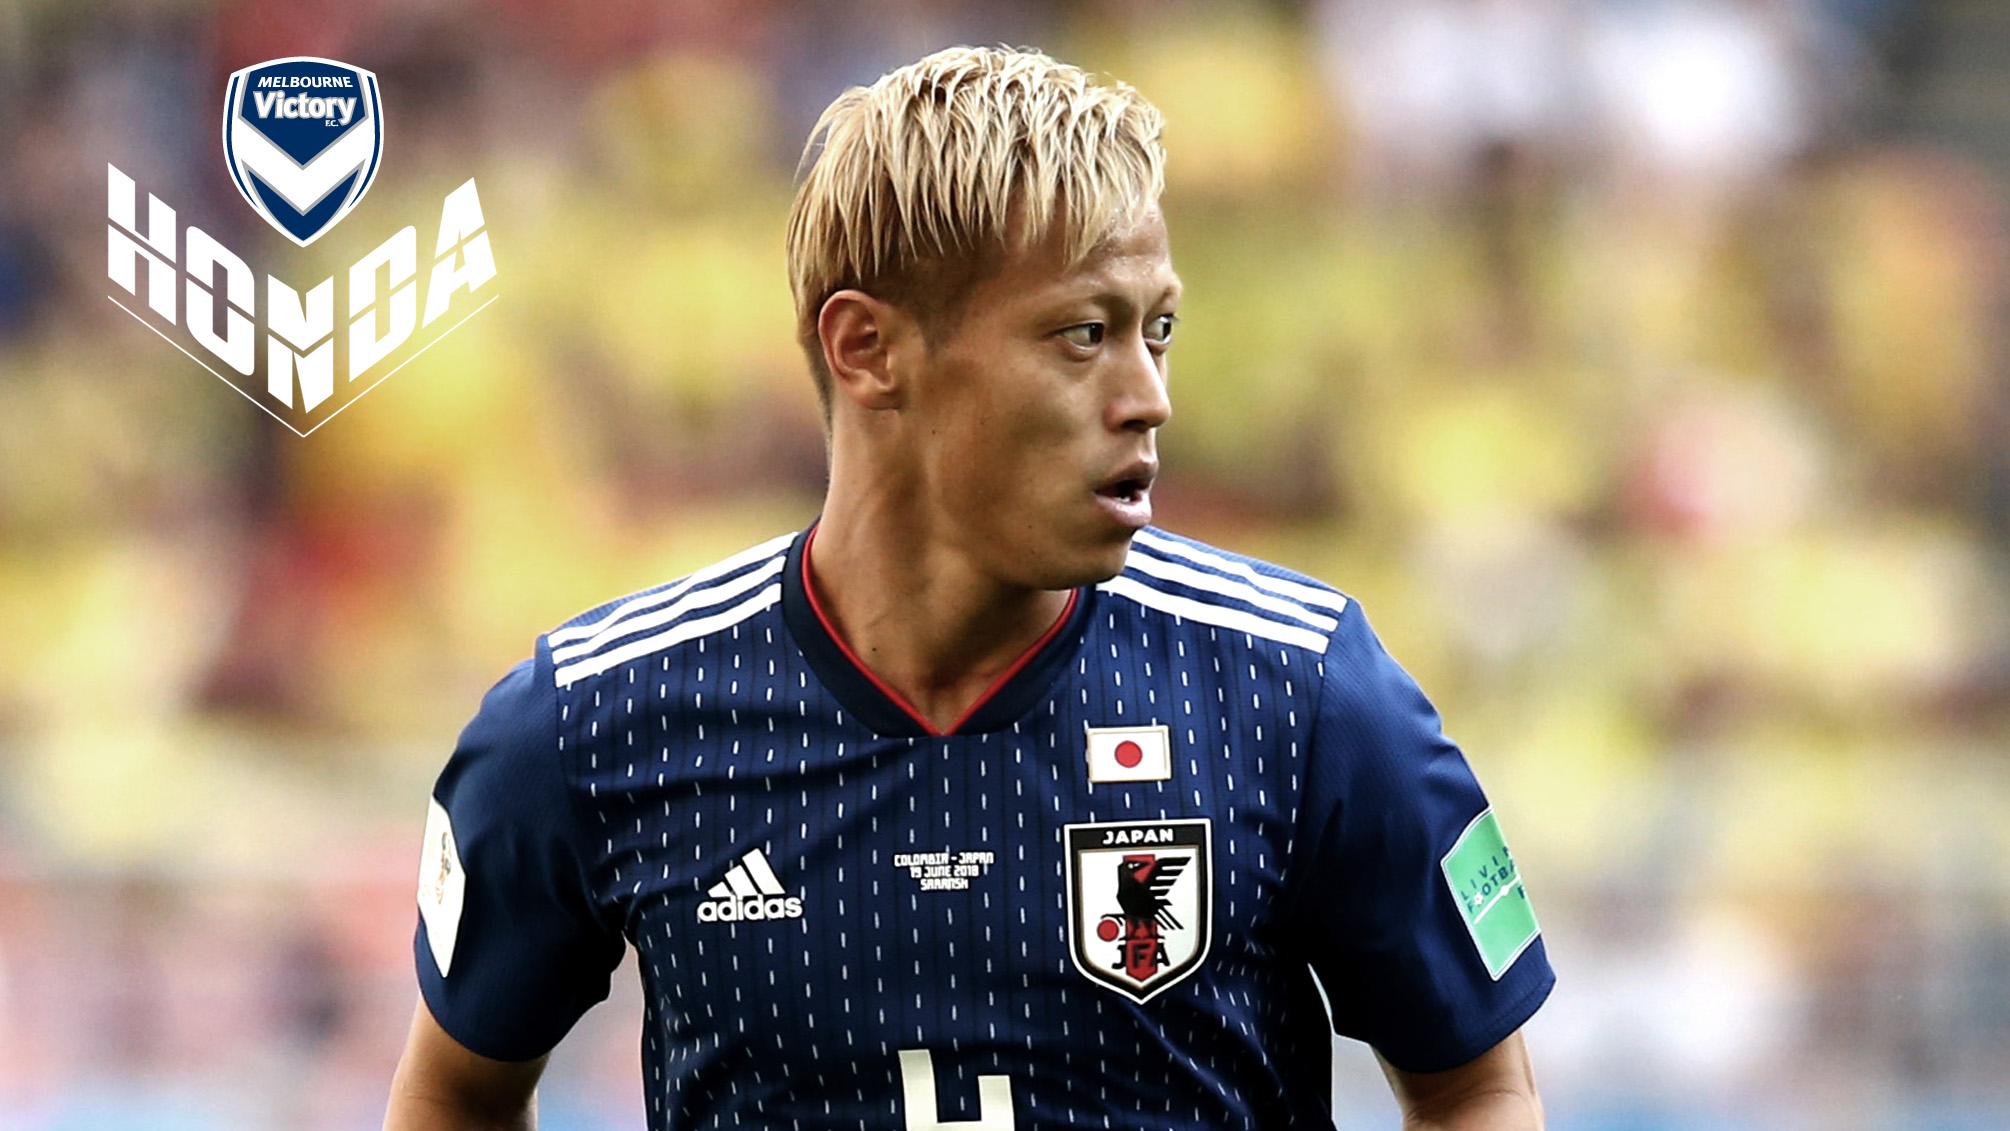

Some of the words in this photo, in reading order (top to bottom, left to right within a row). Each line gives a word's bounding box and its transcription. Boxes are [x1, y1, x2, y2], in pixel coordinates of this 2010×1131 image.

[1102, 828, 1174, 844] JAPAN
[894, 853, 949, 867] COLOMBIA
[959, 852, 994, 864] JAPAN
[910, 866, 922, 878] 19
[924, 865, 951, 877] JUNE
[954, 865, 979, 876] 2018
[697, 893, 803, 922] adidas
[1111, 942, 1170, 970] JFA
